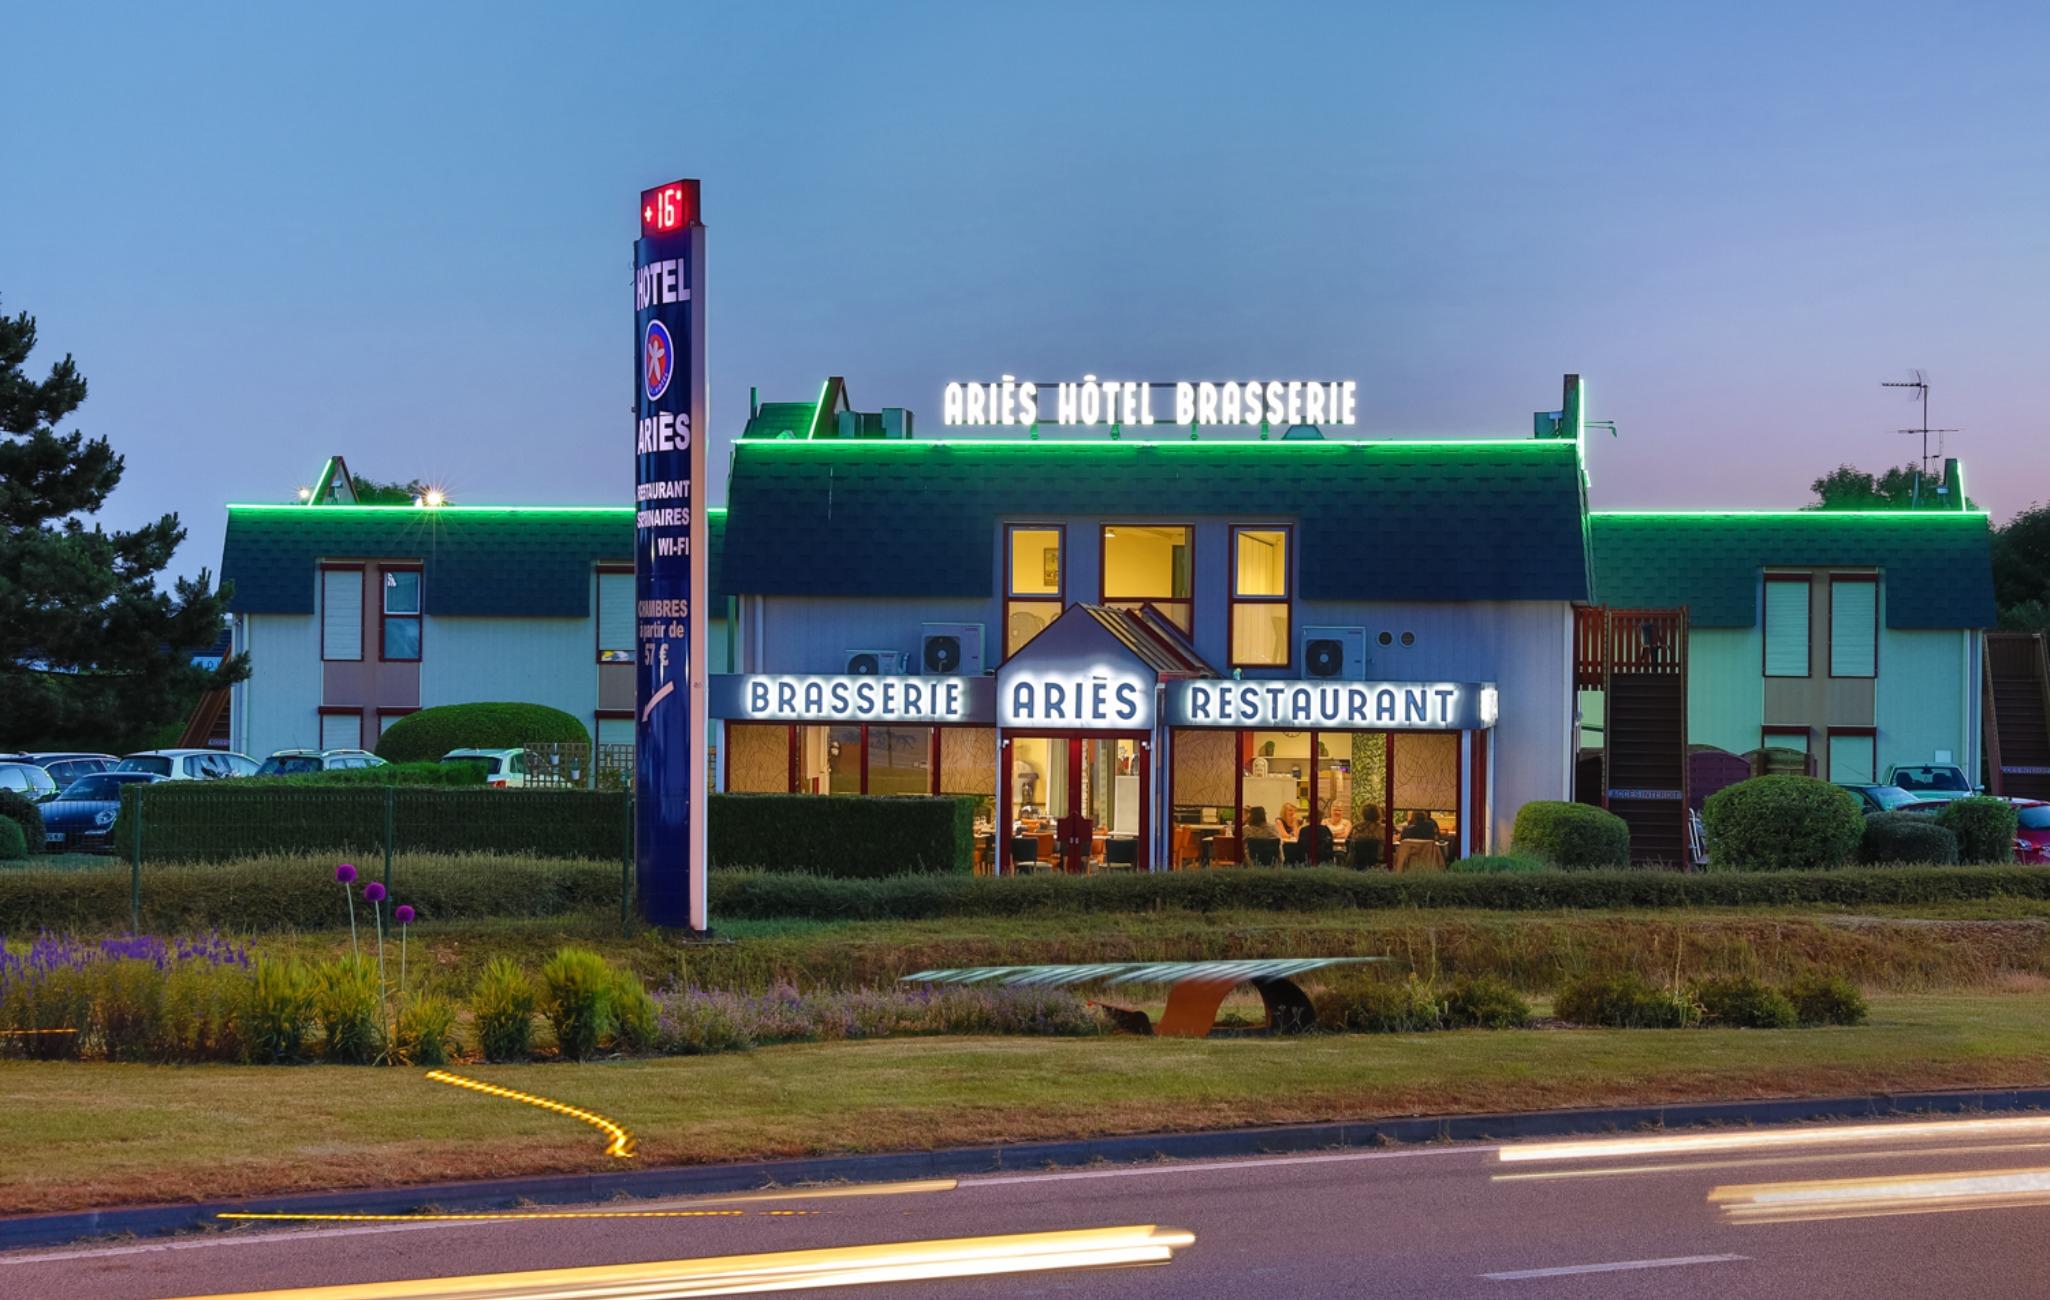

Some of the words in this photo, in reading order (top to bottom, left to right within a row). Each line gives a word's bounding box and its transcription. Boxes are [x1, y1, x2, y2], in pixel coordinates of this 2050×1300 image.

[636, 258, 690, 311] HOTEL
[1176, 380, 1356, 425] BRASSERIE
[658, 537, 690, 556] WI-FI
[638, 600, 688, 617] CHAMBRES
[669, 620, 685, 638] de
[659, 643, 669, 666] €
[751, 681, 959, 715] BRASSERIE
[1192, 687, 1454, 721] RESTAURANT
